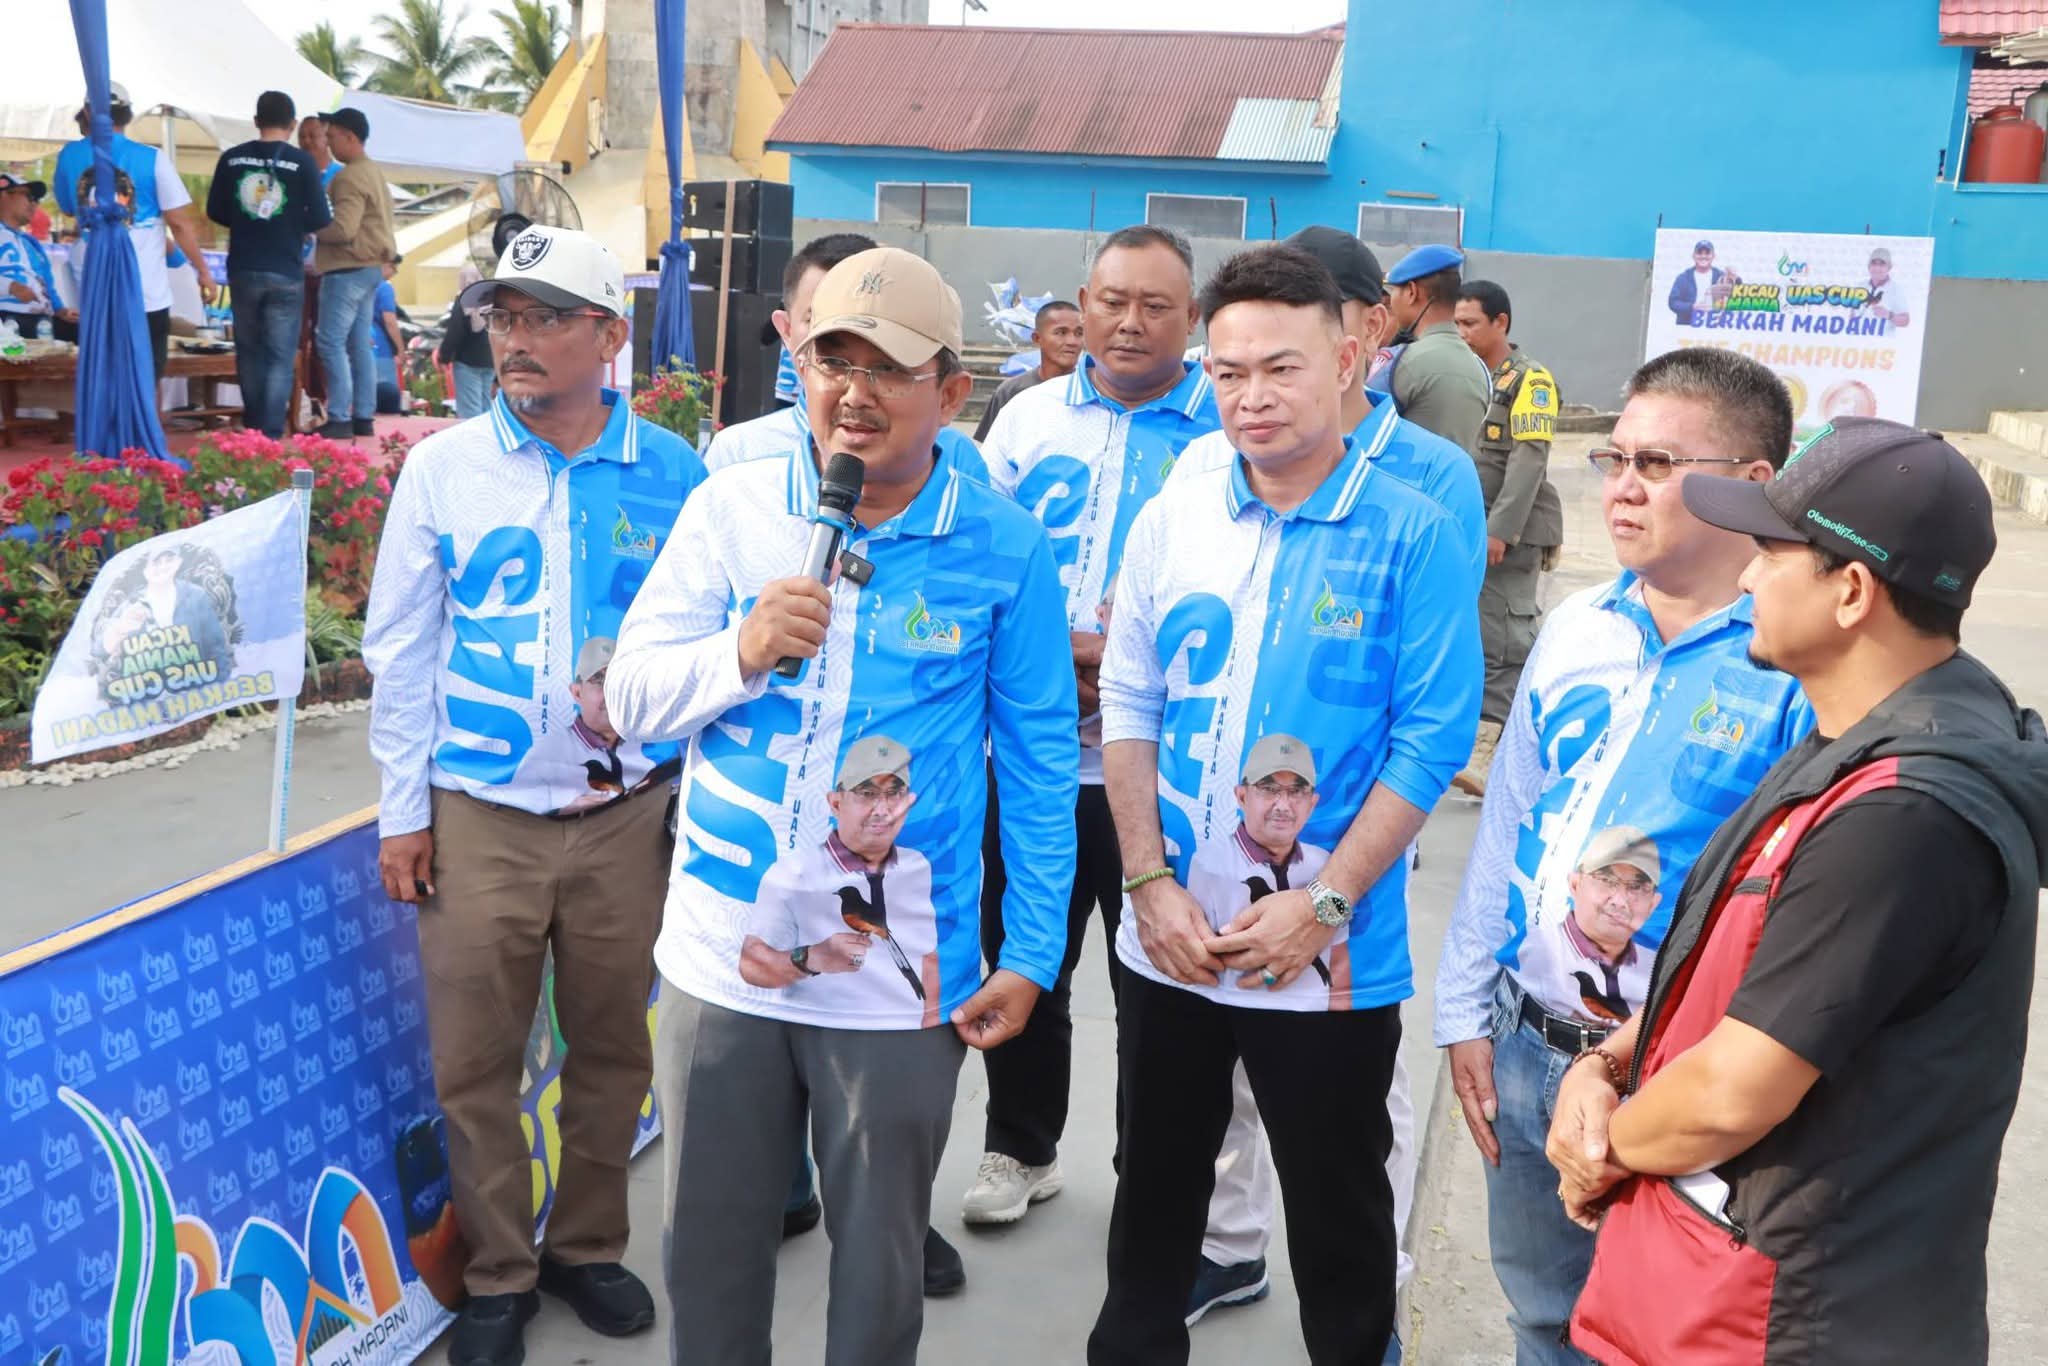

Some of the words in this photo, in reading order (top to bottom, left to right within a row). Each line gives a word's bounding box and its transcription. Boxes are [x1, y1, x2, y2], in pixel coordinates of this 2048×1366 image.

[1732, 284, 1780, 299] KICAU
[1786, 285, 1825, 306] UAS
[1827, 286, 1869, 309] CUP
[1690, 309, 1785, 333] BERKAH
[1791, 313, 1887, 337] MADANI
[1737, 341, 1897, 371] CHAMPIONS
[435, 525, 544, 785] UAS
[541, 693, 549, 735] UAS
[1210, 696, 1229, 776] MANIA
[797, 701, 822, 781] MANIA
[788, 799, 801, 850] UAS
[1204, 793, 1214, 841] UAS
[1534, 875, 1548, 926] UAS
[351, 1303, 410, 1358] MADANI
